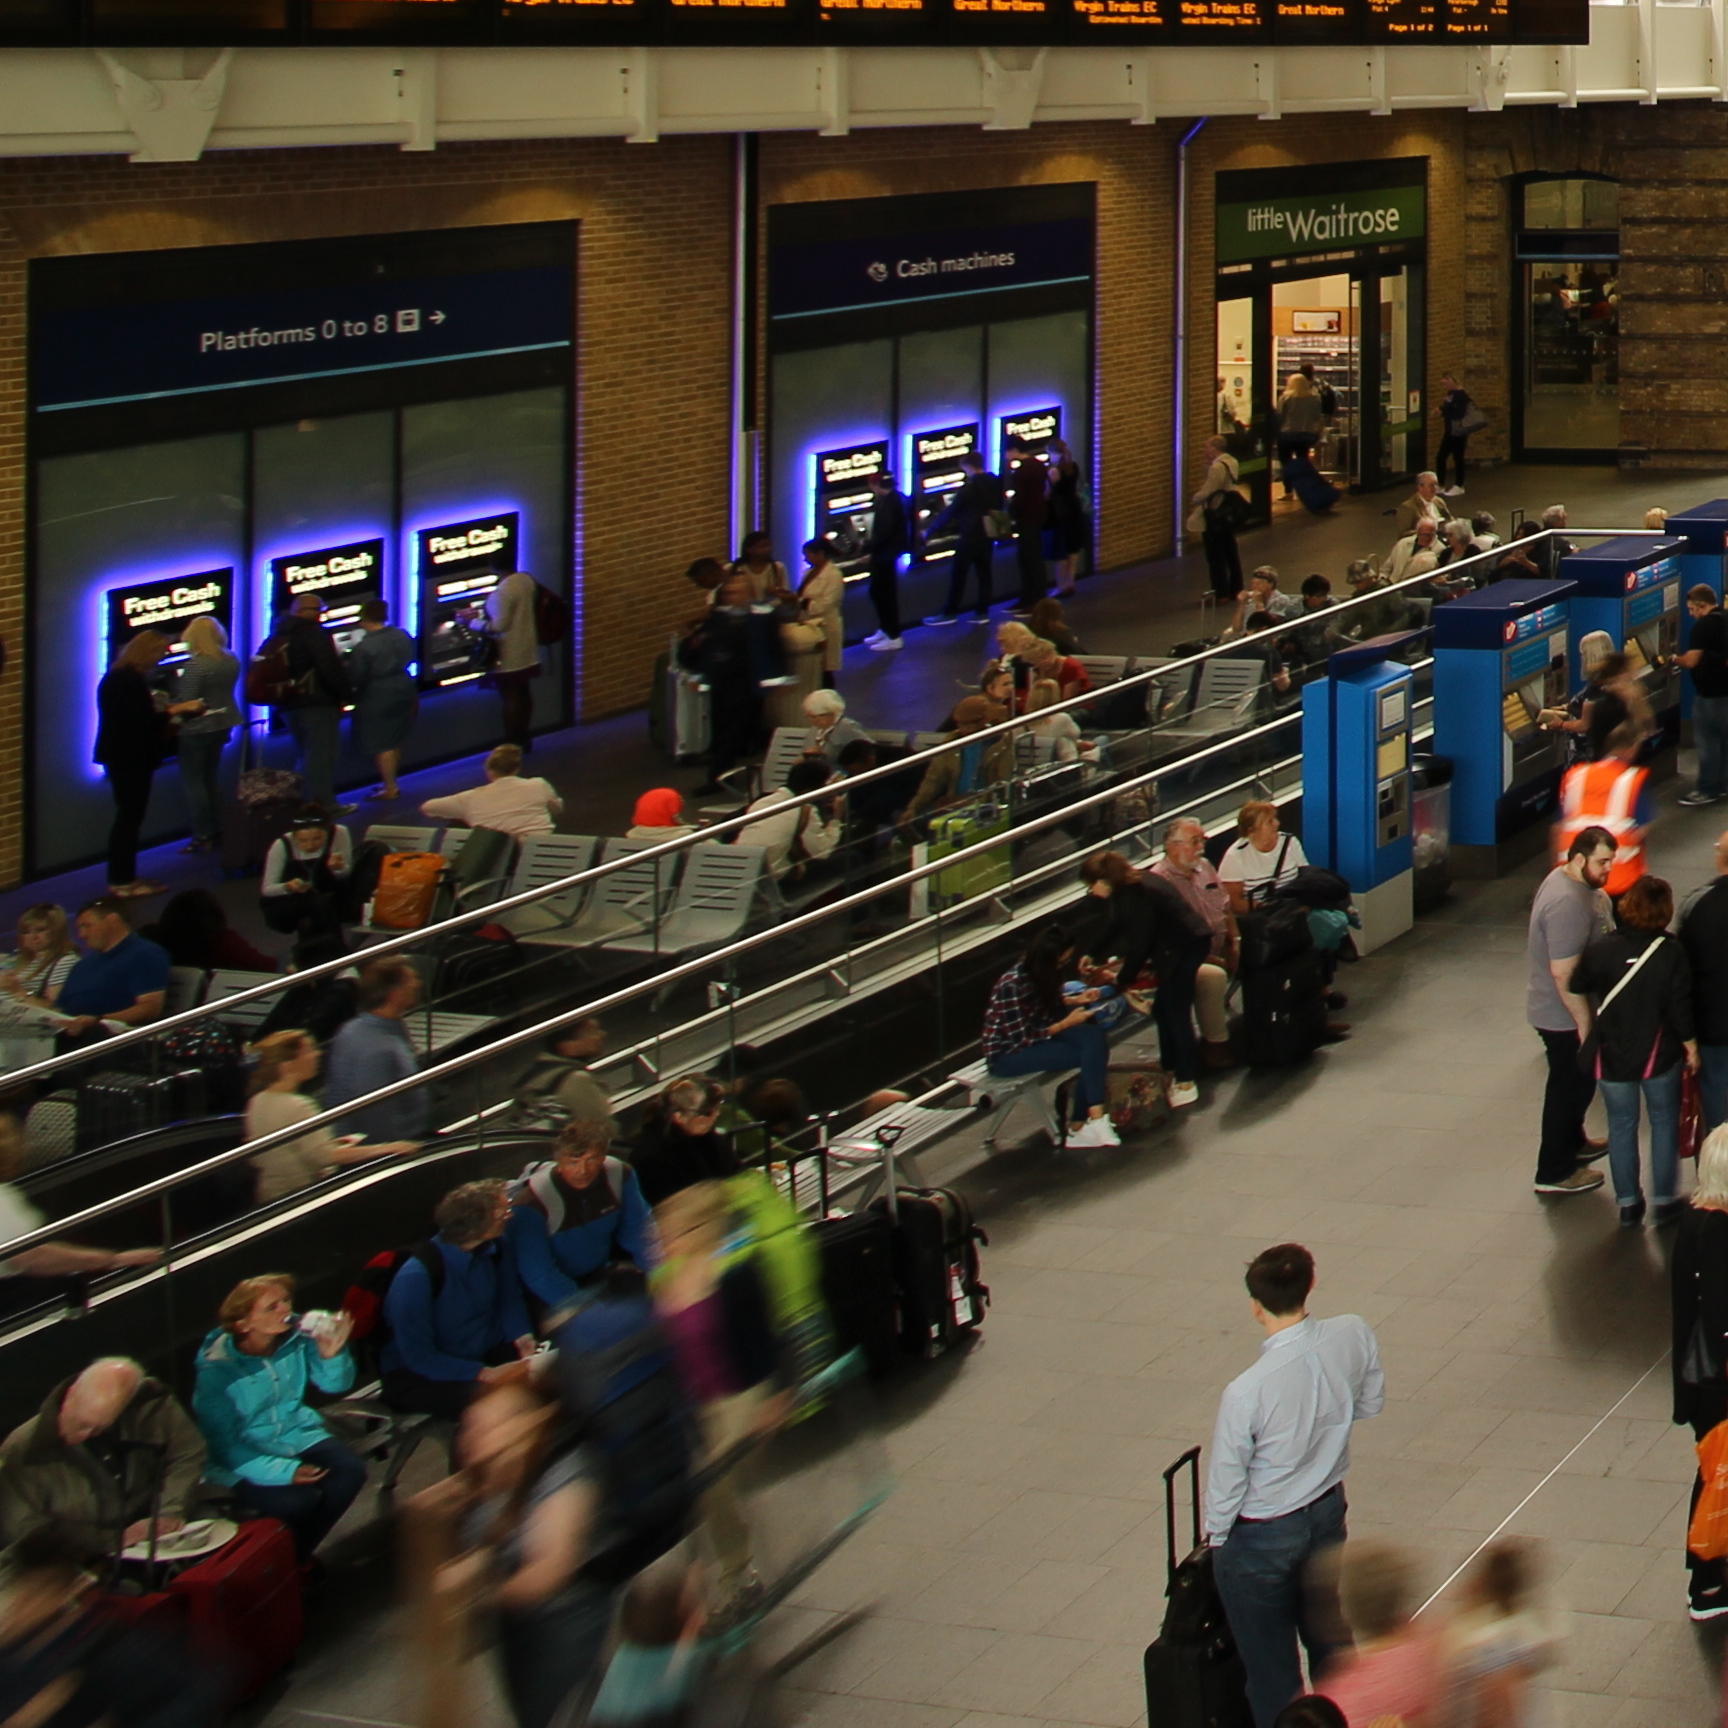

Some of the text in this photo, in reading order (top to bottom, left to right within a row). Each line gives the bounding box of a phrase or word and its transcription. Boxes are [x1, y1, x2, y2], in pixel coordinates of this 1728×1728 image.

[1246, 201, 1400, 242] little Waitrose
[895, 250, 1016, 277] Cash machines
[199, 313, 389, 352] Platforms 0 to 8
[428, 525, 509, 554] Free Cash
[285, 552, 374, 583] Free Cash
[123, 582, 222, 616] Free Cash
